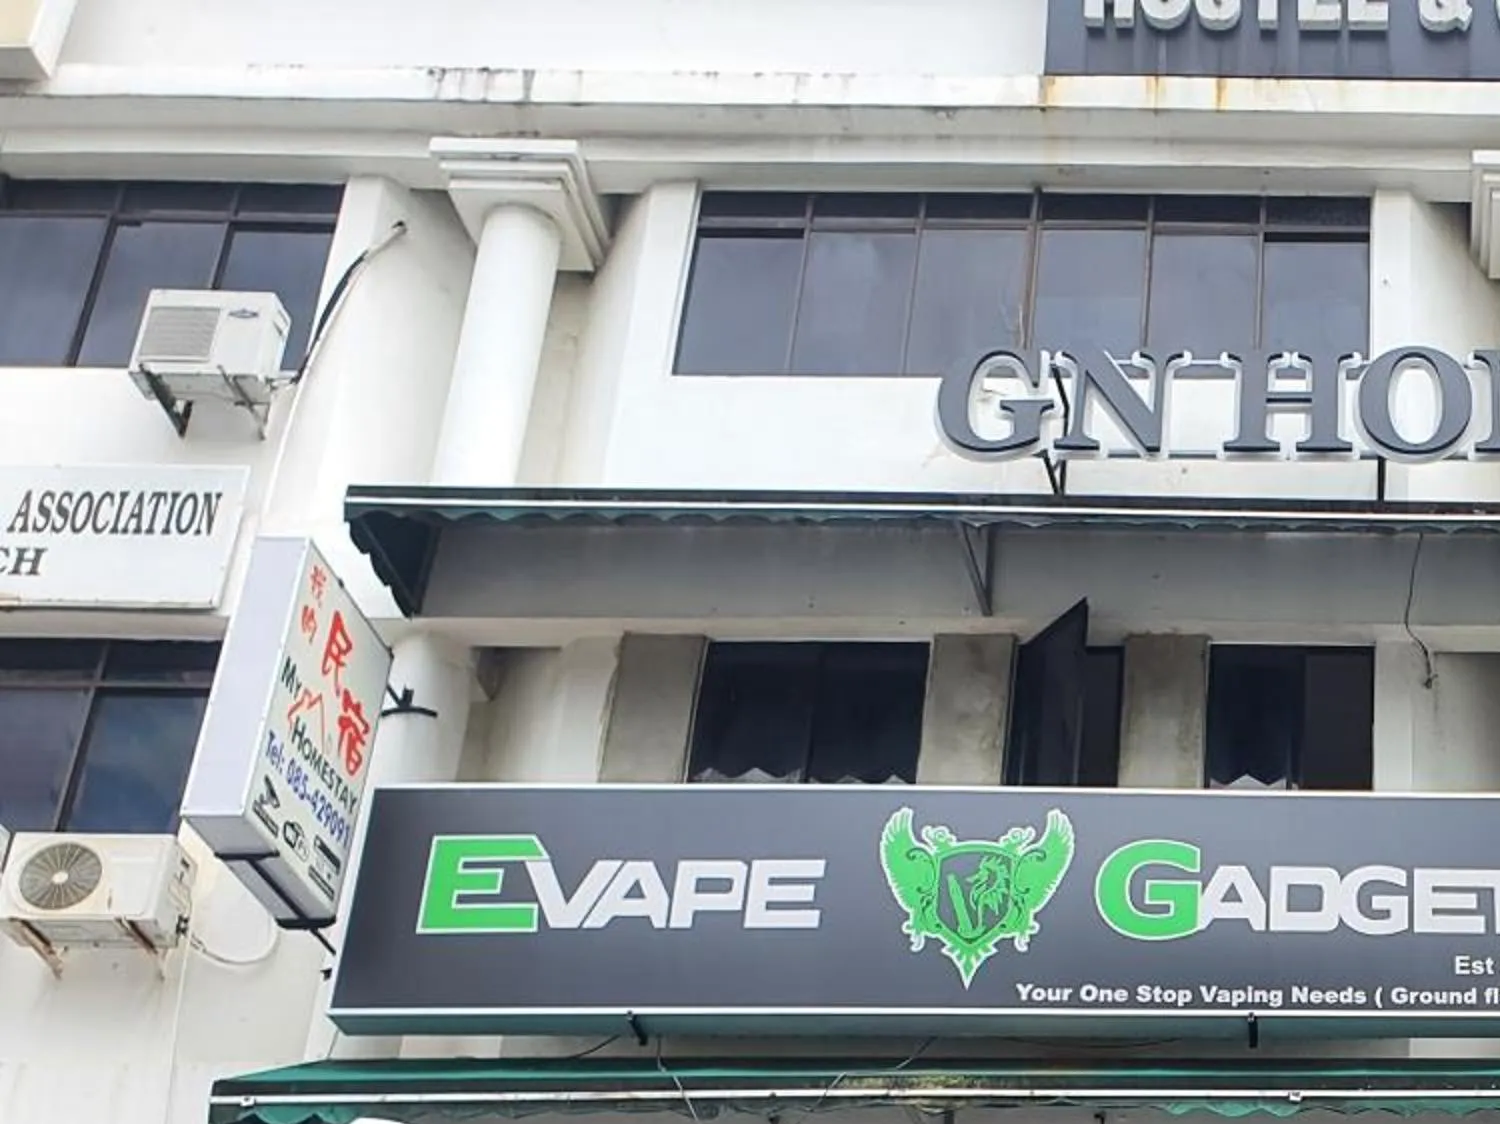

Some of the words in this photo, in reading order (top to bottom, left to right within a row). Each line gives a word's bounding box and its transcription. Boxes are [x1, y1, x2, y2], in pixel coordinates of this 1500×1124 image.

[938, 349, 1182, 460] GN
[6, 489, 223, 536] ASSOCIATION
[286, 758, 351, 848] 085-429091
[416, 834, 826, 934] EVAPE
[1016, 984, 1072, 1003] Your
[1080, 985, 1128, 1003] One
[1136, 986, 1192, 1007] Stop
[1201, 986, 1283, 1008] Vaping
[1291, 986, 1367, 1005] Needs
[1390, 987, 1476, 1006] Ground
[1455, 956, 1494, 975] Est
